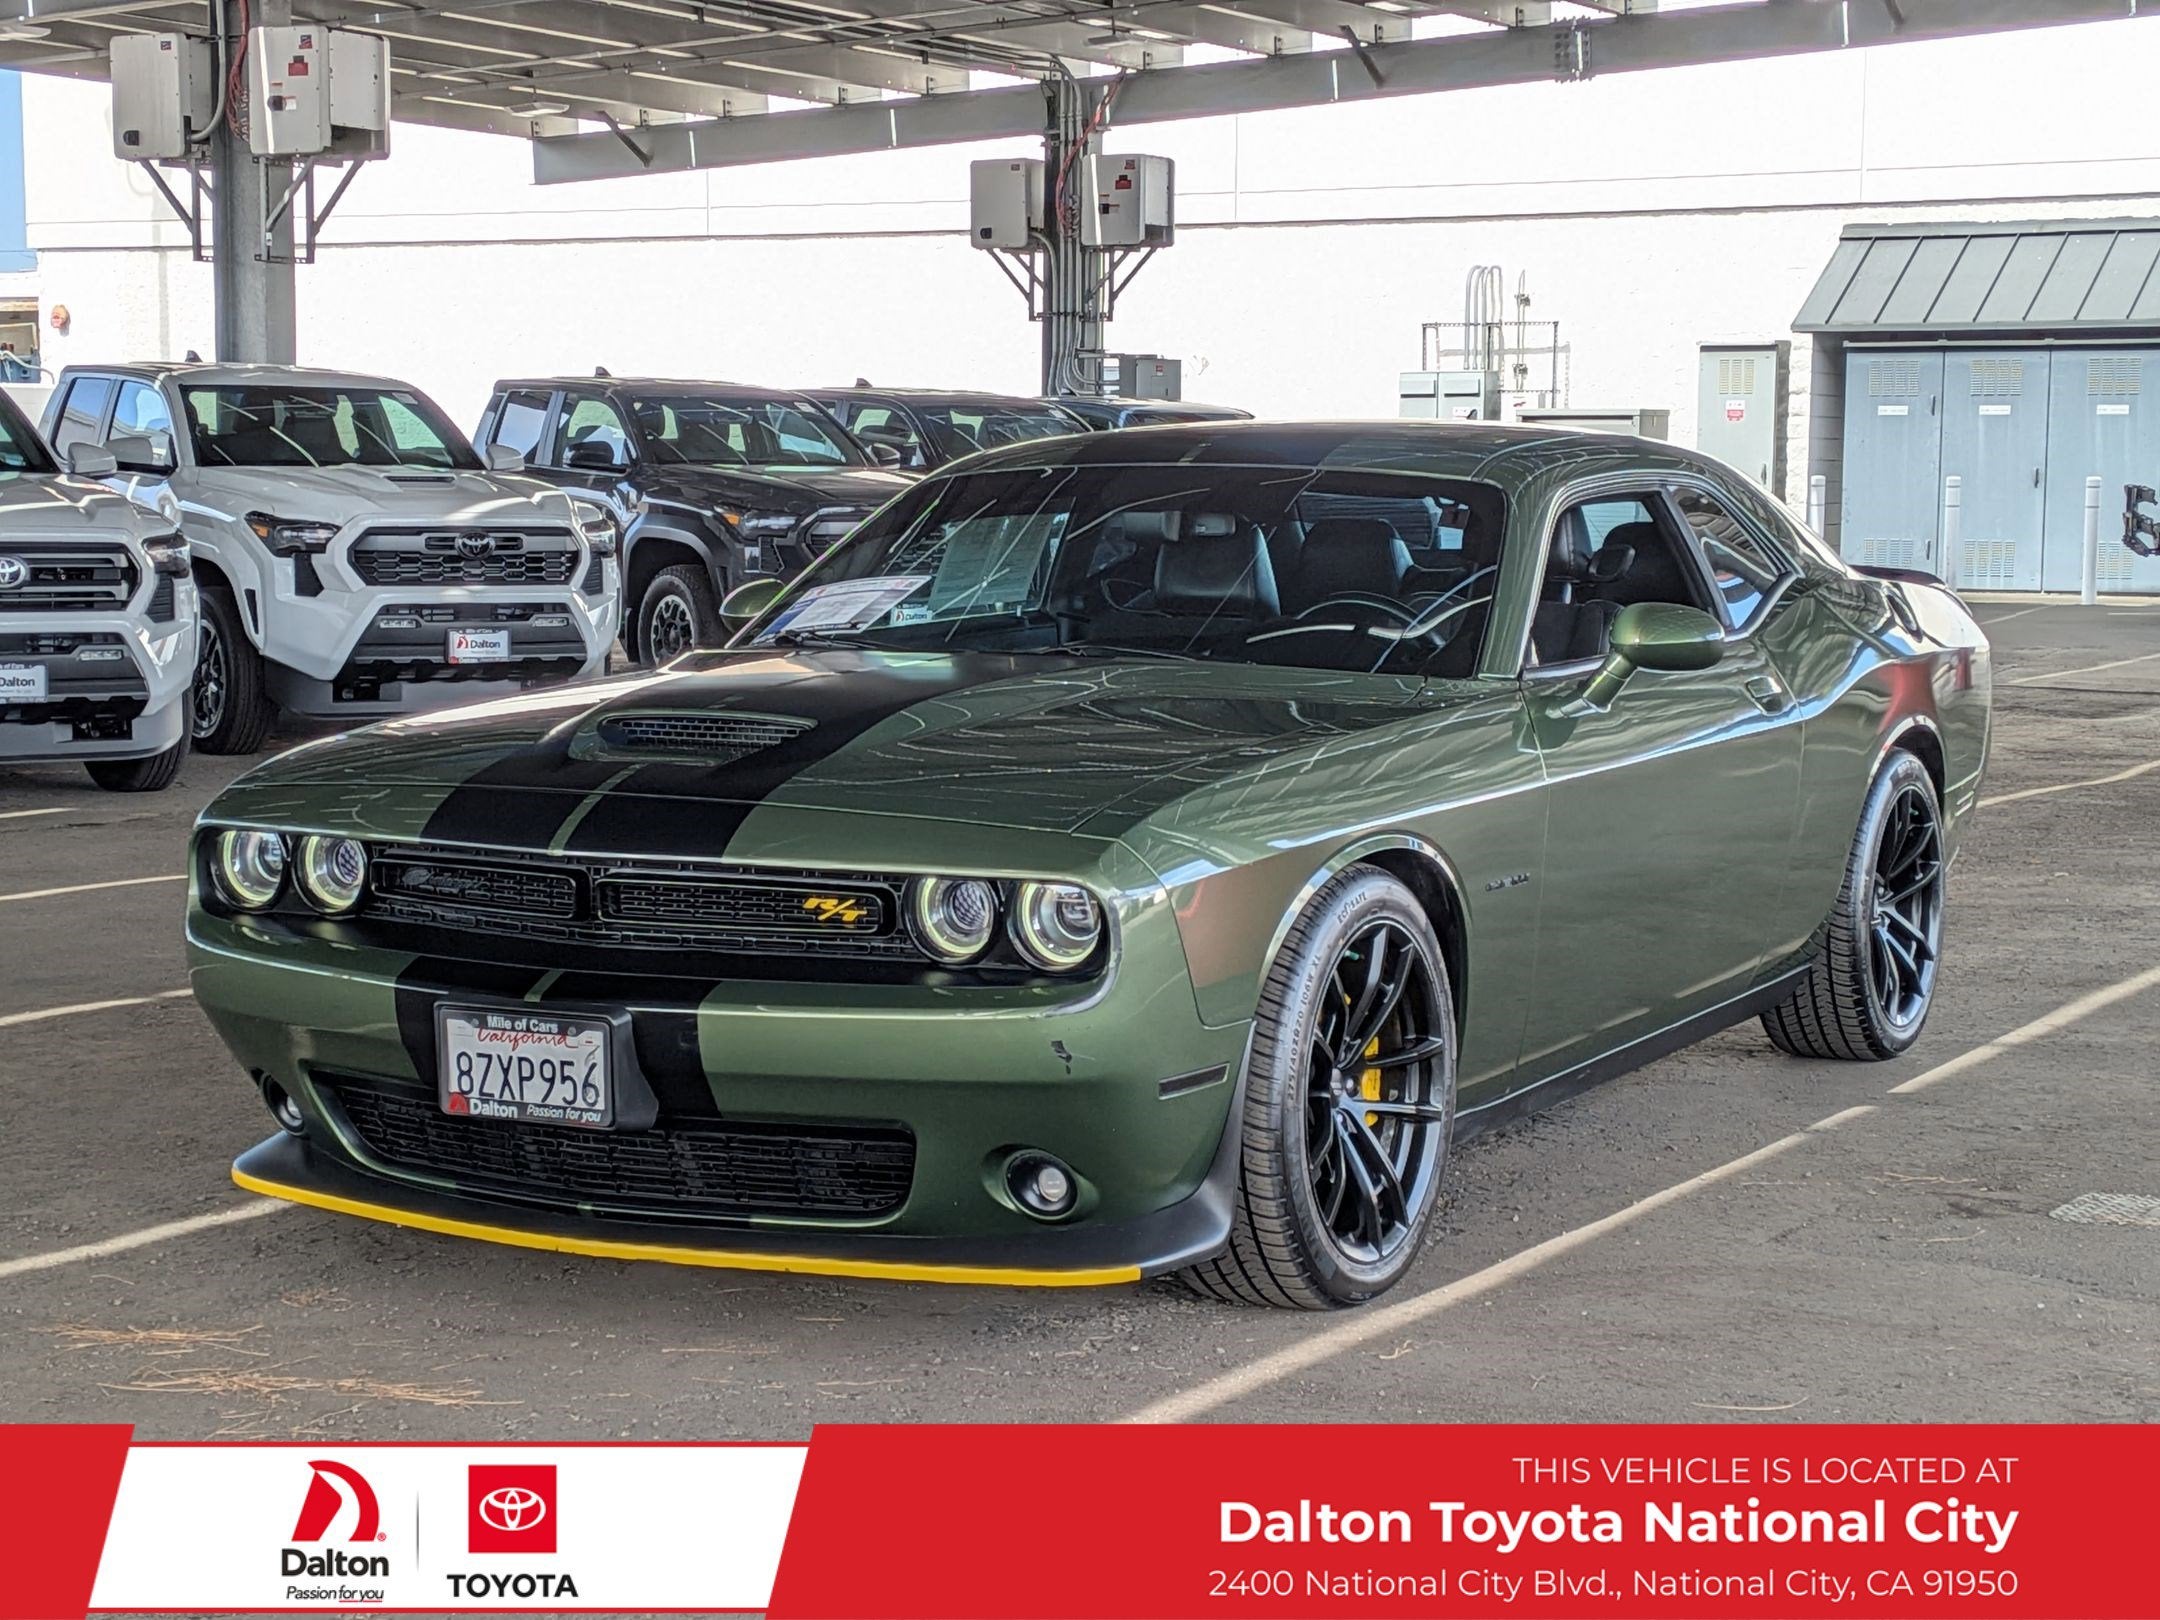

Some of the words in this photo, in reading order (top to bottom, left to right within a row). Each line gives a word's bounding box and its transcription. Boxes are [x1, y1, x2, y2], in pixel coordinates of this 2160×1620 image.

[470, 639, 501, 649] Dalton
[0, 676, 35, 687] Dalton
[802, 897, 868, 921] R/T
[487, 1015, 513, 1031] Mile
[514, 1017, 528, 1031] of
[529, 1018, 559, 1034] Cars
[456, 1051, 600, 1107] 8ZXP956
[469, 1099, 518, 1119] Dalton
[526, 1103, 563, 1119] Passion
[565, 1106, 581, 1121] for
[581, 1110, 602, 1124] you
